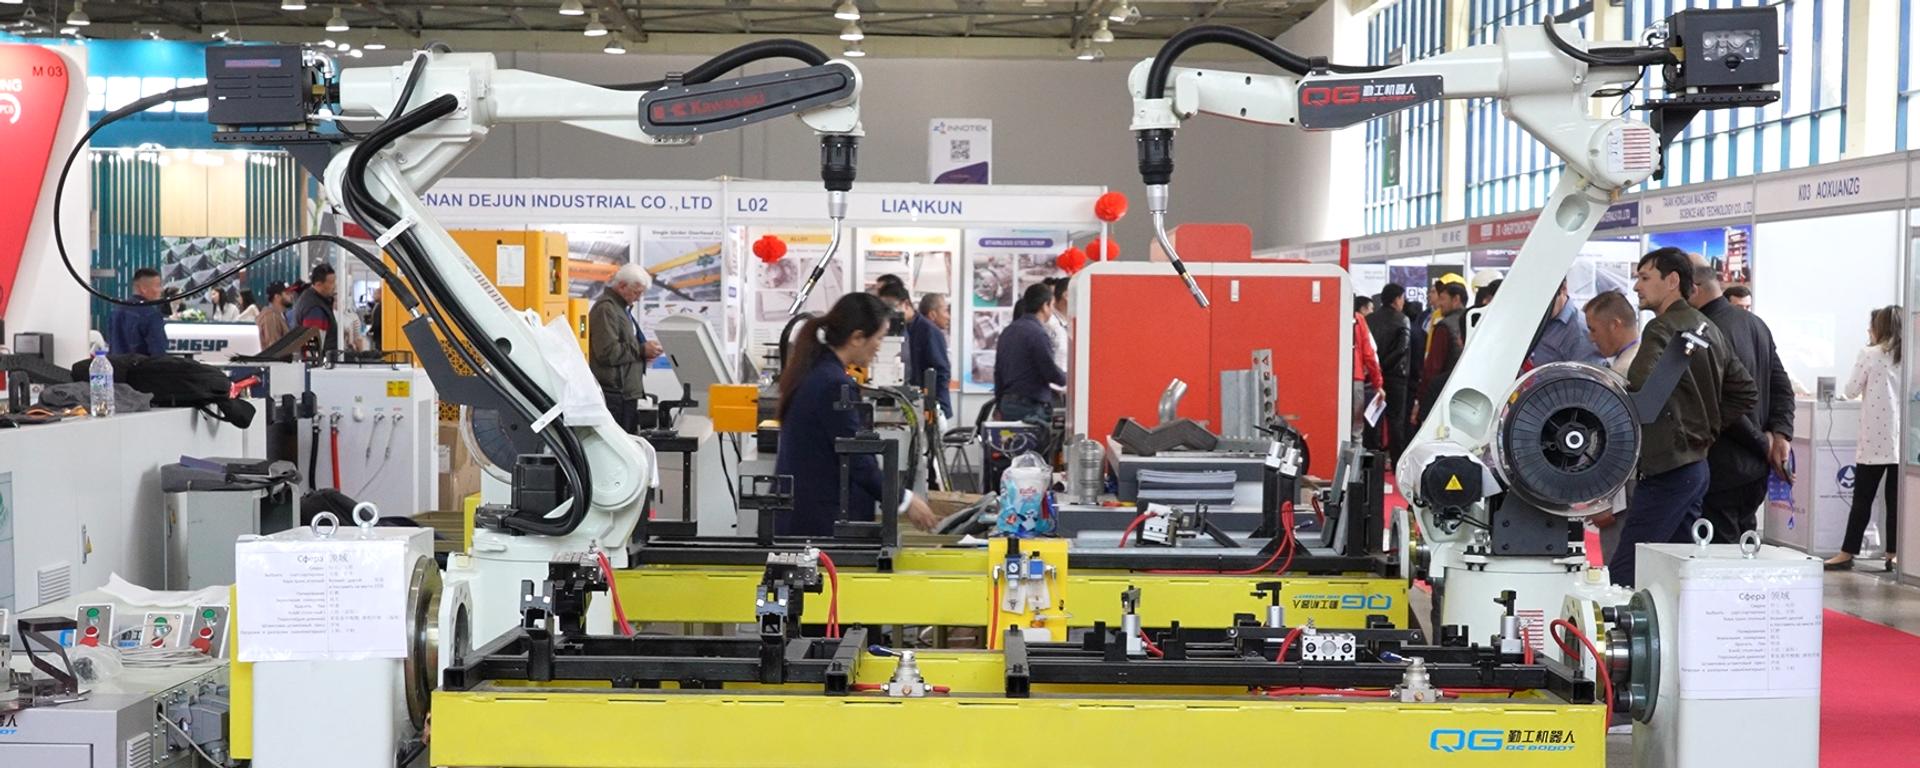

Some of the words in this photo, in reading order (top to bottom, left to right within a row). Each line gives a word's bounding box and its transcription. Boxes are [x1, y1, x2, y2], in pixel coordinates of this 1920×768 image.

[33, 66, 43, 77] M
[47, 65, 63, 77] 03
[1302, 86, 1360, 107] QG
[1363, 83, 1417, 97] 勤工机器人
[690, 90, 765, 115] Kawasaki
[947, 124, 988, 132] INNOTEK
[1798, 184, 1812, 201] K03
[1816, 177, 1860, 200] AOXUANZG
[469, 194, 526, 208] DEJUN
[532, 194, 636, 209] INDUSTRIAL
[738, 198, 769, 212] L02
[882, 199, 963, 215] LIANKUN
[1706, 204, 1734, 217] TECHNOLOGY
[167, 339, 228, 352] СИБУР
[297, 555, 324, 564] Сфера
[1292, 599, 1340, 610] 勤工机器人
[1341, 593, 1393, 610] QG
[1739, 593, 1766, 602] Сфера
[1429, 729, 1505, 753] QG
[1507, 729, 1576, 744] 勤工机器人
